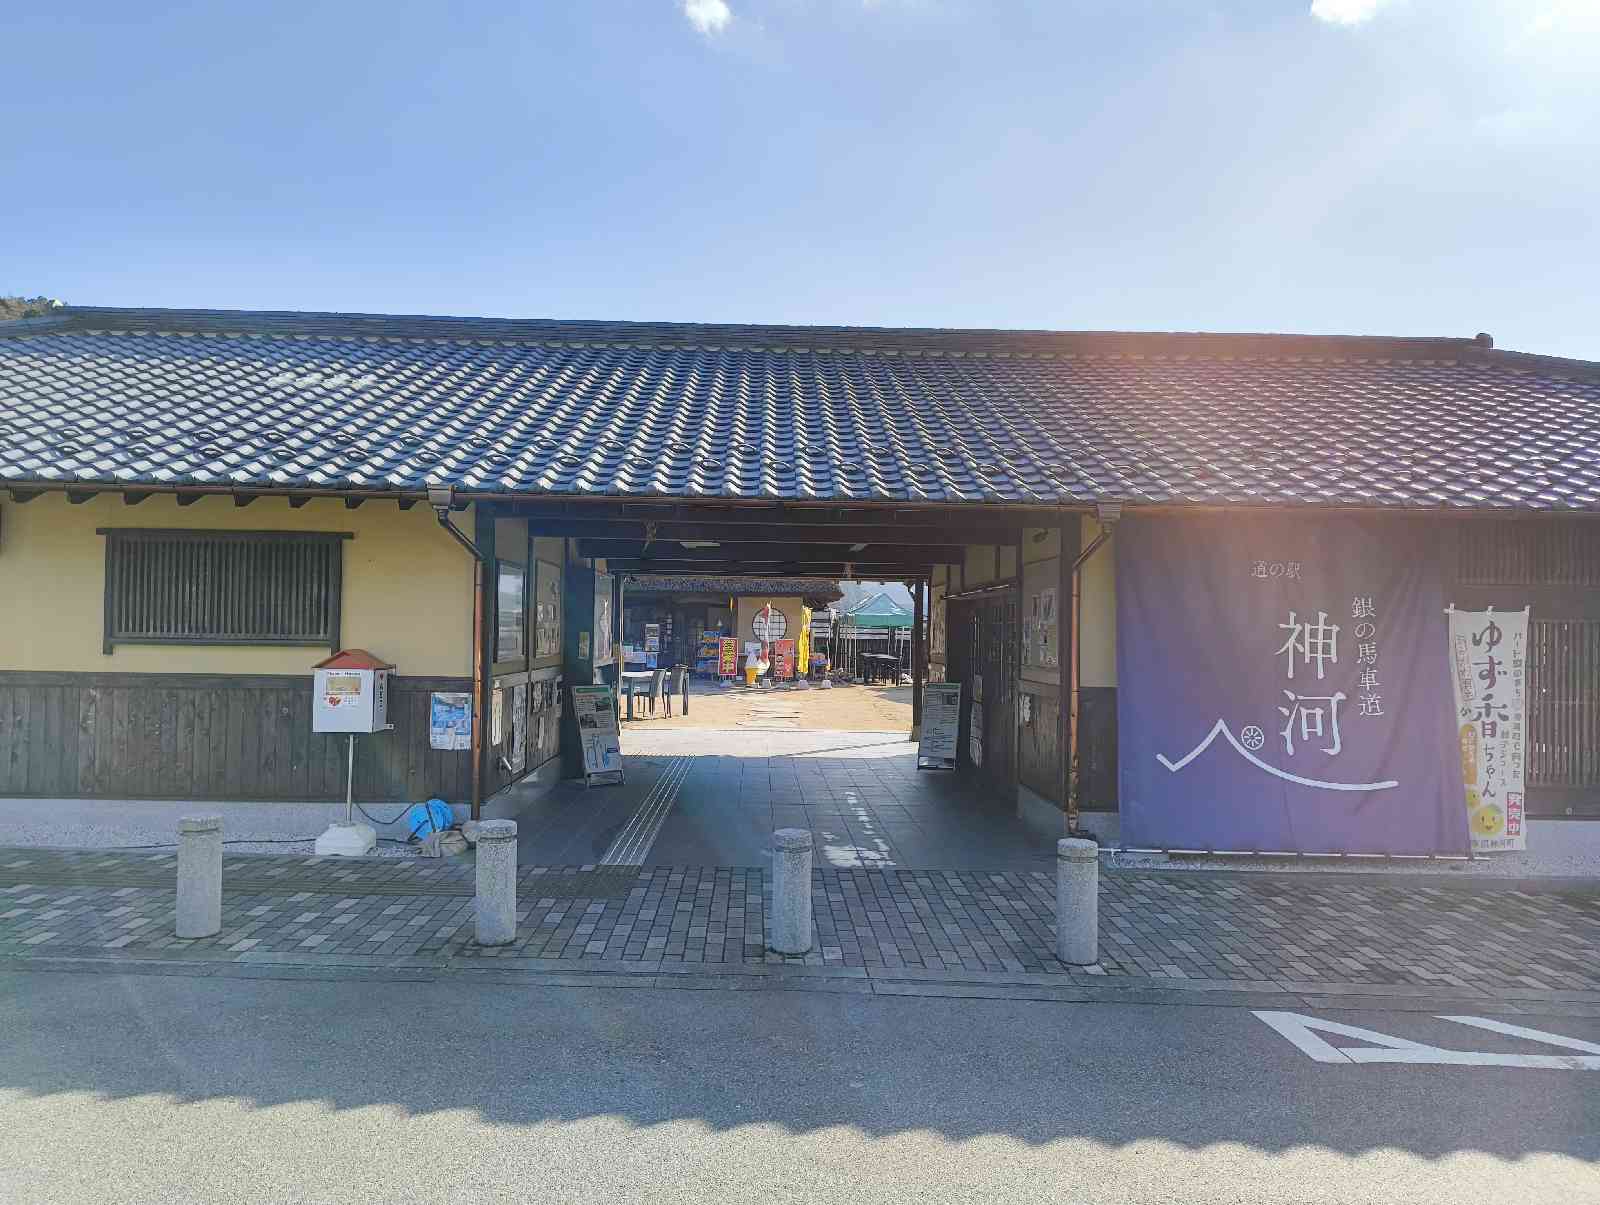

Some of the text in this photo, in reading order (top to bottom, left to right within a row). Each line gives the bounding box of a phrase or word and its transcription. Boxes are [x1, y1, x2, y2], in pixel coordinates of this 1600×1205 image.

[1251, 560, 1301, 579] 道の駅
[1274, 611, 1347, 756] 神河
[1351, 597, 1384, 717] 銀の馬車道
[1471, 620, 1510, 798] ゆず香ちゃん
